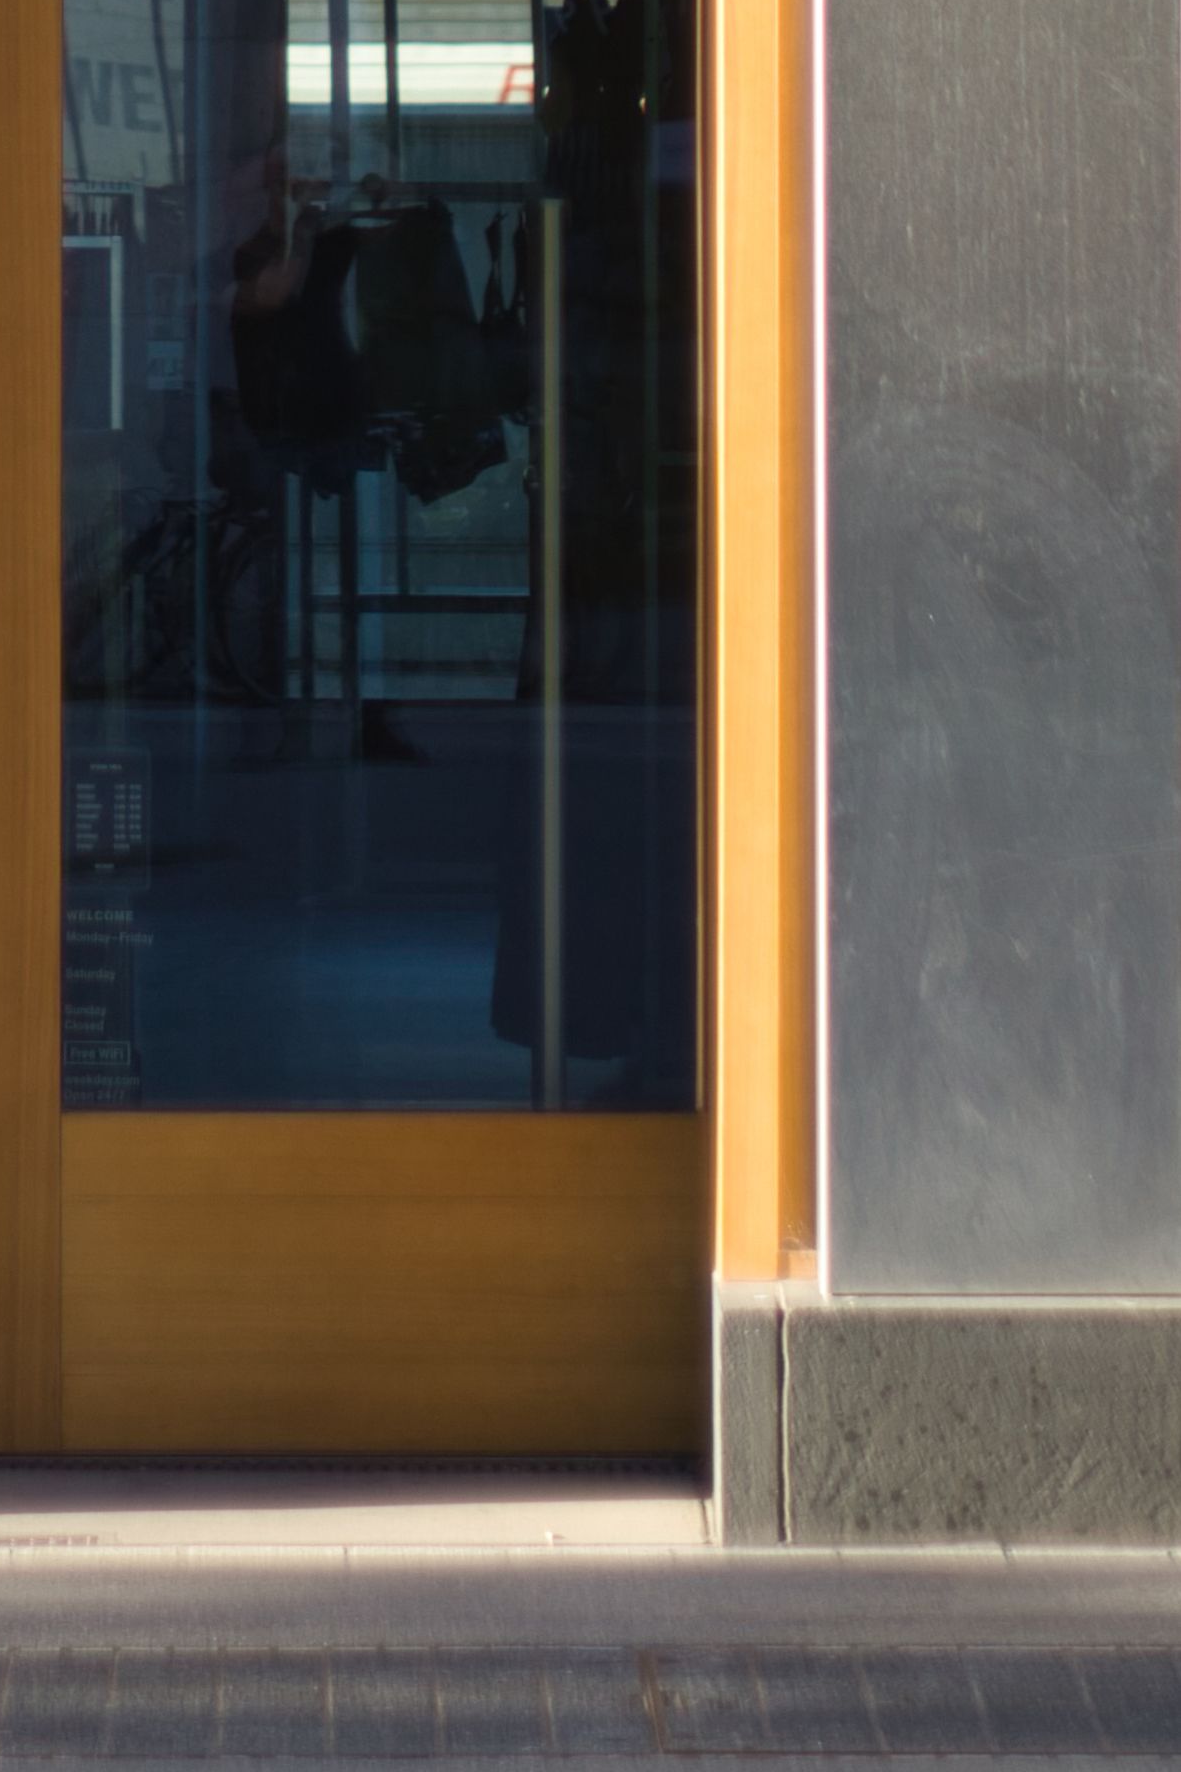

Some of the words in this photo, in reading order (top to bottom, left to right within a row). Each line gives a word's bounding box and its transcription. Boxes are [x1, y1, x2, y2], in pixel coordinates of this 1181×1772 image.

[66, 910, 134, 921] WELCOME
[66, 968, 116, 982] Saturday
[65, 1005, 106, 1018] Sunday
